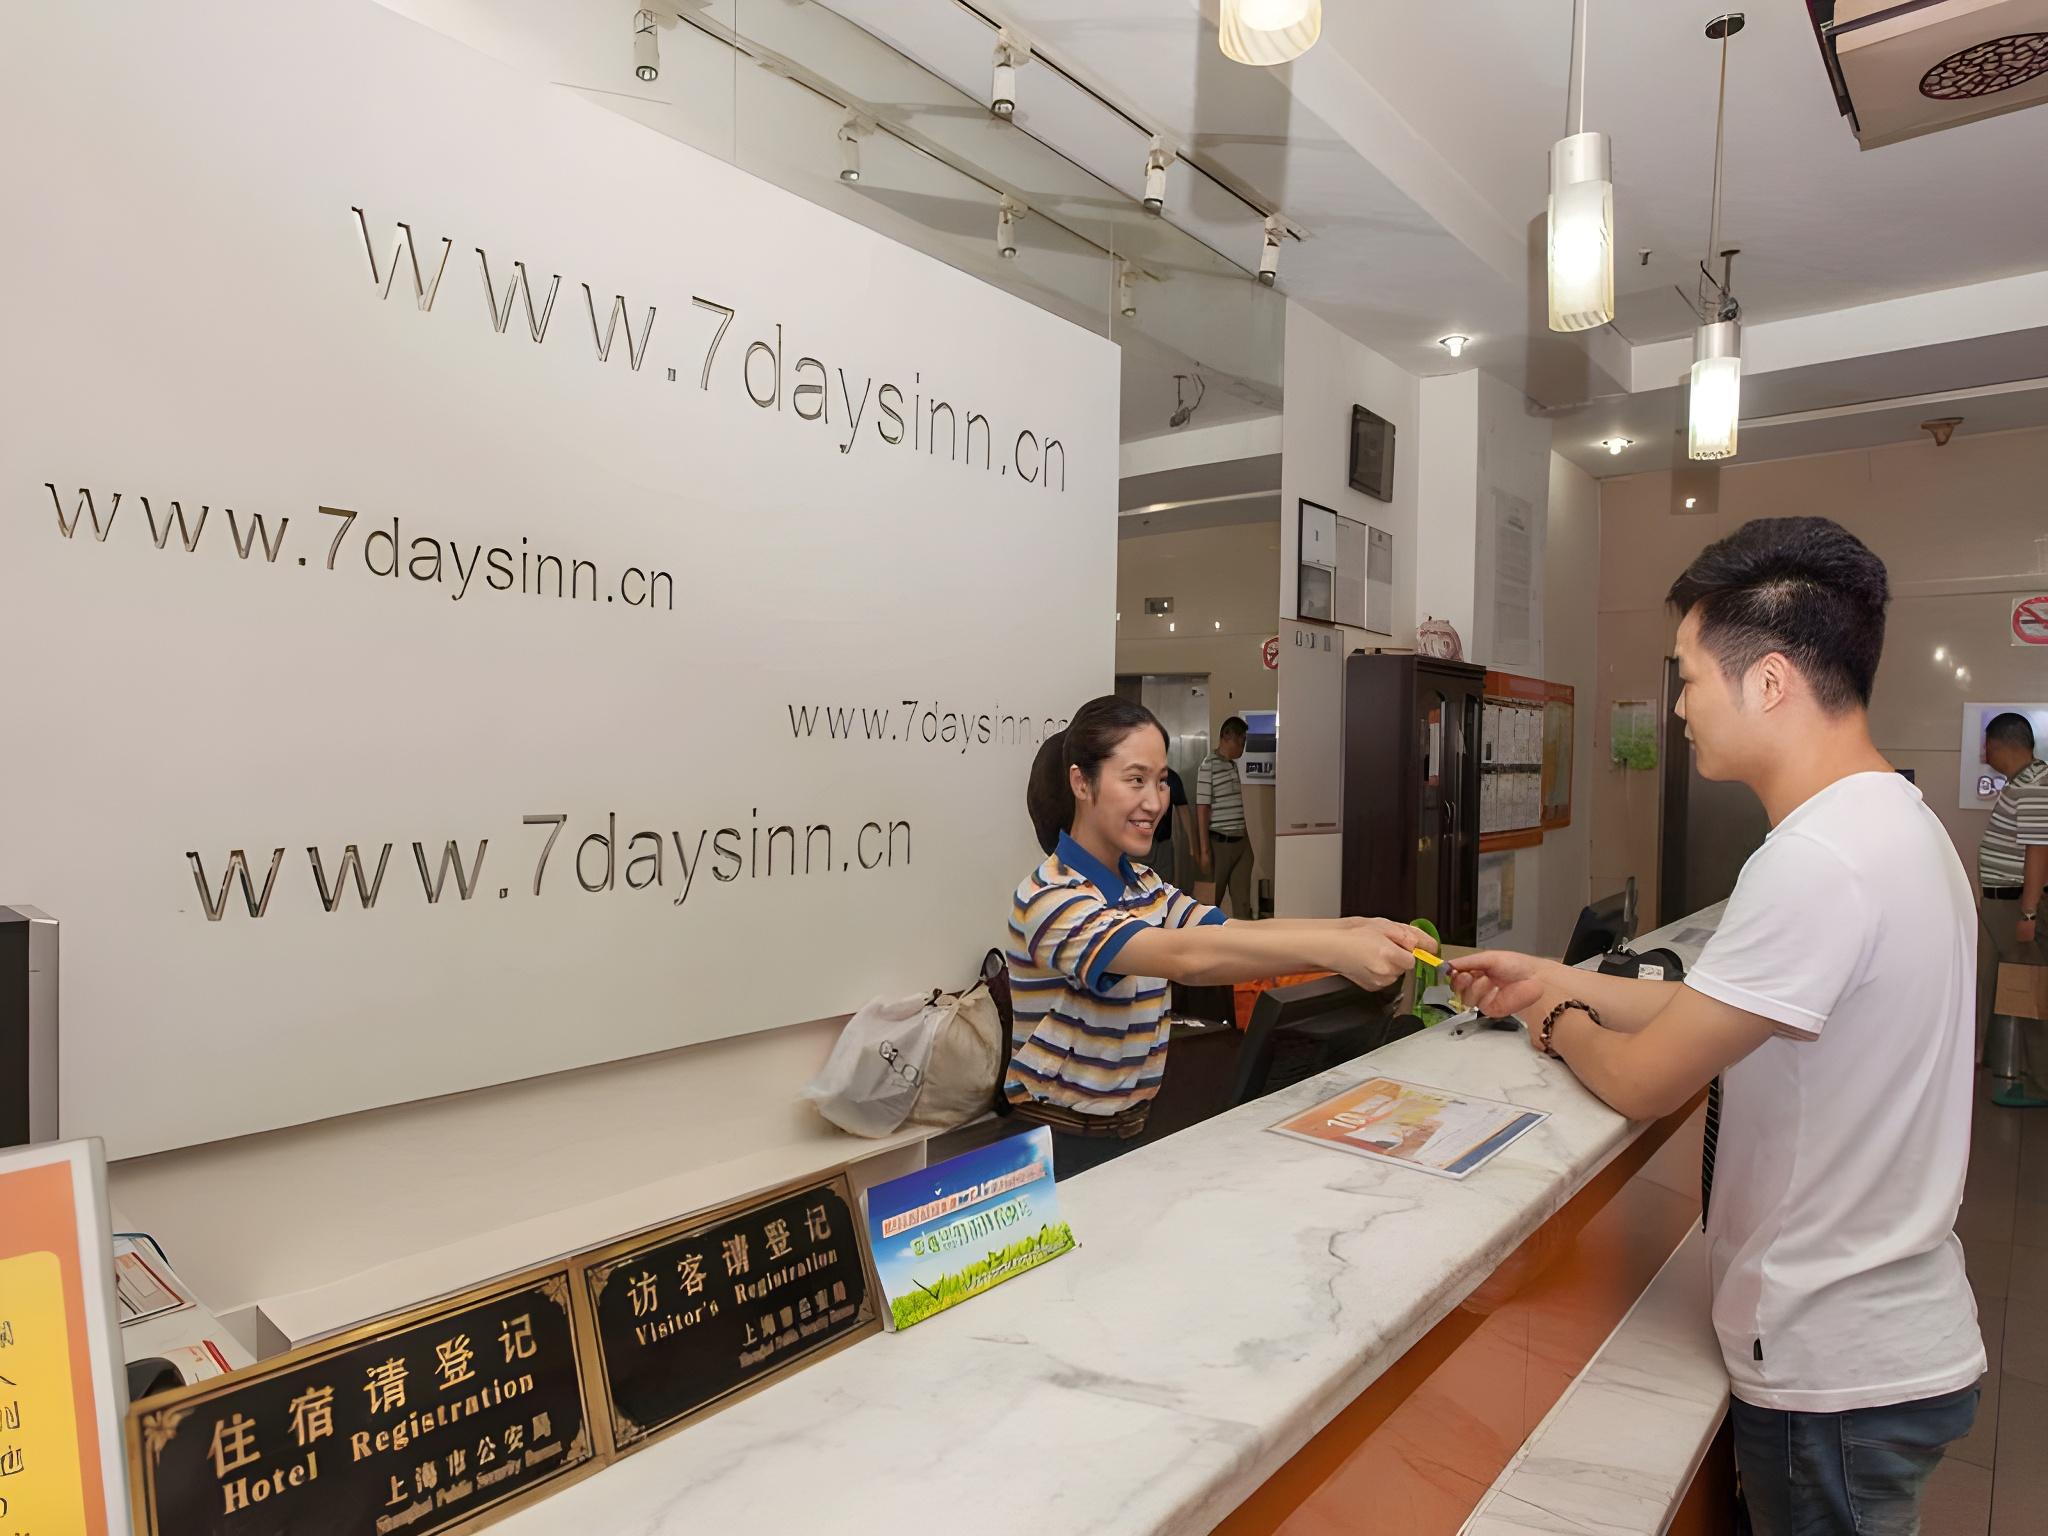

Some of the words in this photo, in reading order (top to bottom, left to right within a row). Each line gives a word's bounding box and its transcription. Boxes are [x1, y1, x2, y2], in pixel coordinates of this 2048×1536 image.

[351, 206, 1066, 492] www.7daysinn.cn
[45, 483, 674, 610] www.7daysinn.cn
[186, 808, 911, 922] www.7daysinn.cn
[207, 1312, 538, 1480] 住宿请登记
[221, 1450, 318, 1516] Hotel
